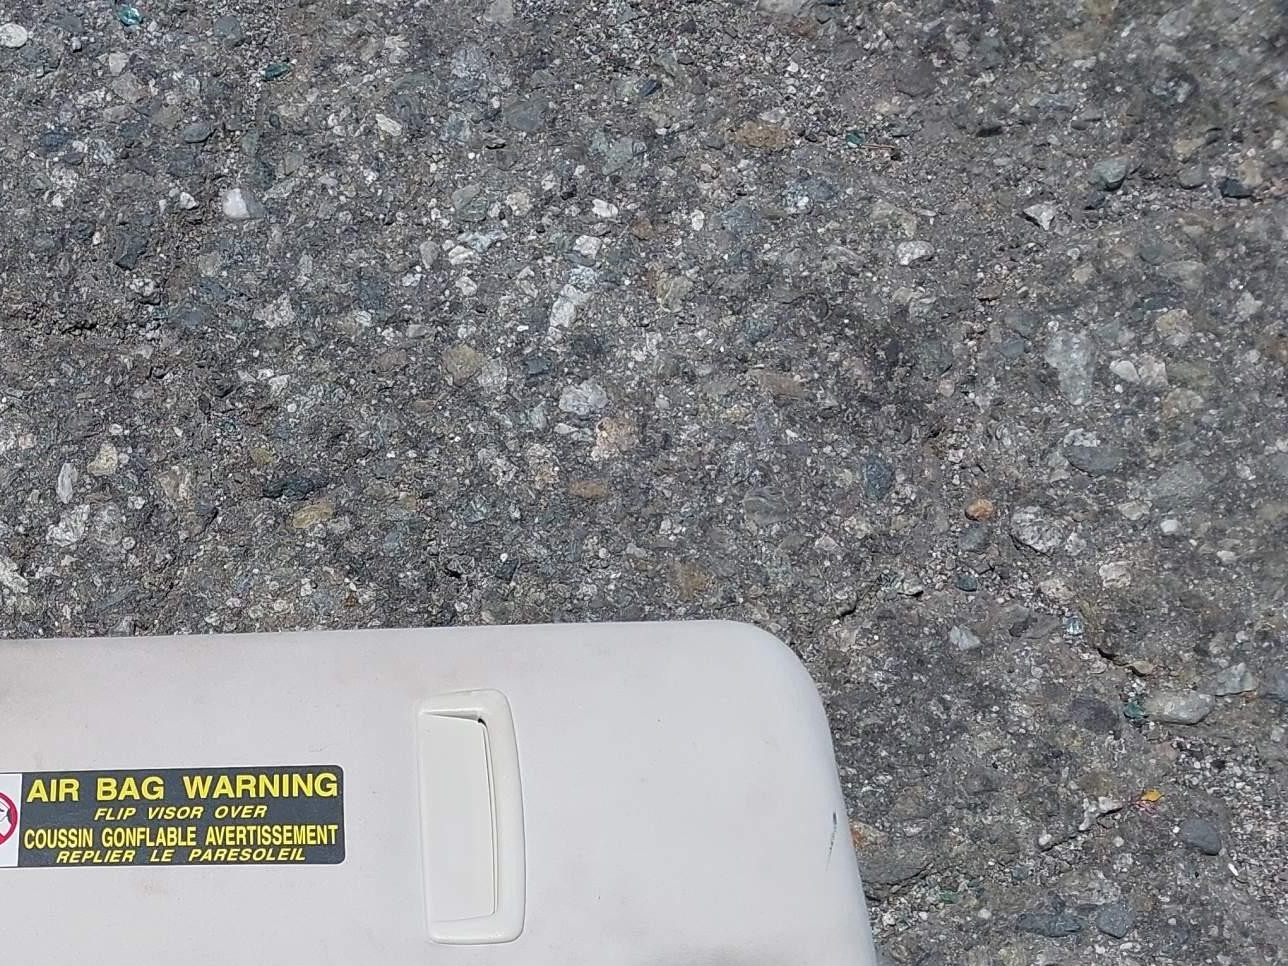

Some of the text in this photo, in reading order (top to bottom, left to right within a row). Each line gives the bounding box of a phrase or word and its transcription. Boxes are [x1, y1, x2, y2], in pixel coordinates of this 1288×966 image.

[27, 772, 338, 802] AIR BAG WARNING
[94, 805, 267, 820] FLIP VISOR OVER
[24, 824, 338, 849] COUSSIN GONFLABLE AVERTISSEMENT
[56, 848, 307, 863] REPLIER LE PARESOLEIL
